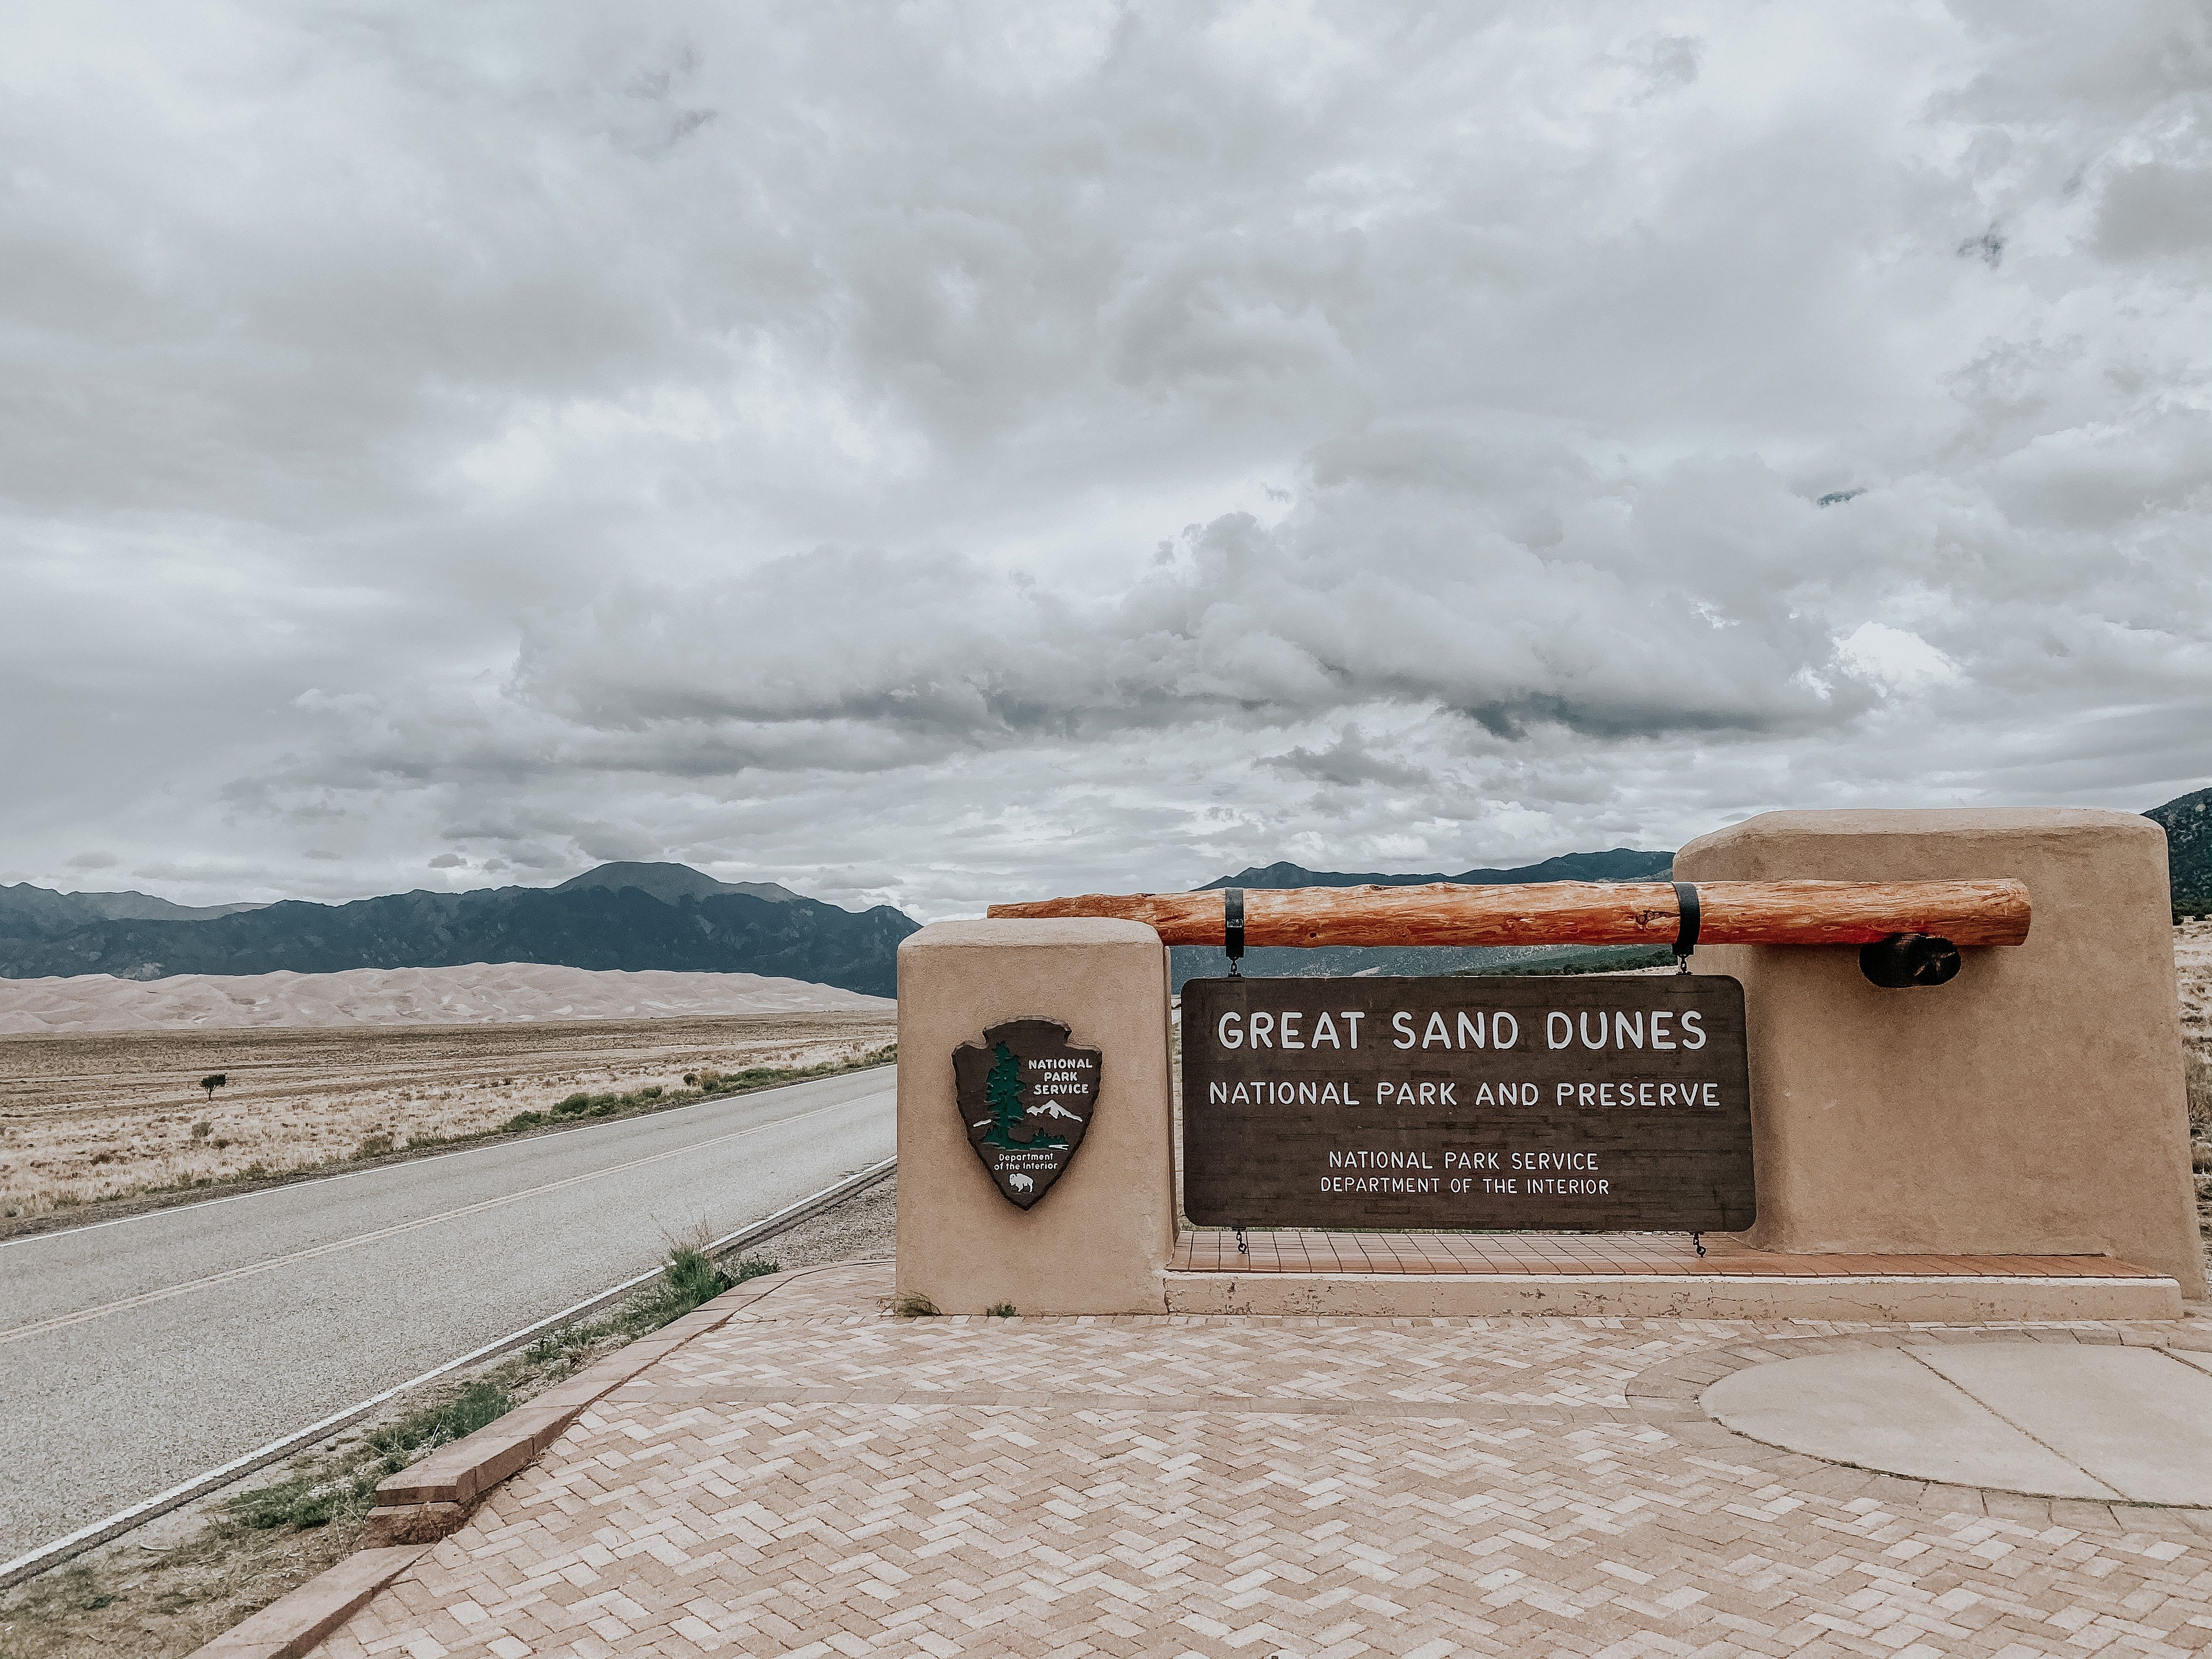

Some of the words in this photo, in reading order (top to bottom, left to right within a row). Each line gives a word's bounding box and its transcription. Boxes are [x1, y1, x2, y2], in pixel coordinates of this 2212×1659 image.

[1218, 1011, 1365, 1049] GREAT
[1392, 1011, 1519, 1049] SAND
[1547, 1010, 1706, 1049] DUNES
[1028, 1058, 1093, 1070] NATIONAL
[1044, 1071, 1077, 1082] PARK
[1033, 1084, 1089, 1095] SERVICE
[1210, 1081, 1360, 1105] NATIONAL
[1377, 1082, 1457, 1105] PARK
[1475, 1082, 1539, 1106] AND
[1557, 1082, 1720, 1107] PRESERVE
[999, 1153, 1053, 1163] Department
[1329, 1151, 1433, 1169] NATIONAL
[1445, 1152, 1500, 1170] PARK
[1511, 1152, 1599, 1170] SERVICE
[994, 1161, 1004, 1171] of
[1023, 1161, 1058, 1170] Interior
[1321, 1177, 1440, 1193] DEPARTMENT
[1450, 1178, 1472, 1193] OF
[1482, 1178, 1517, 1194] THE
[1527, 1179, 1609, 1195] INTERIOR
